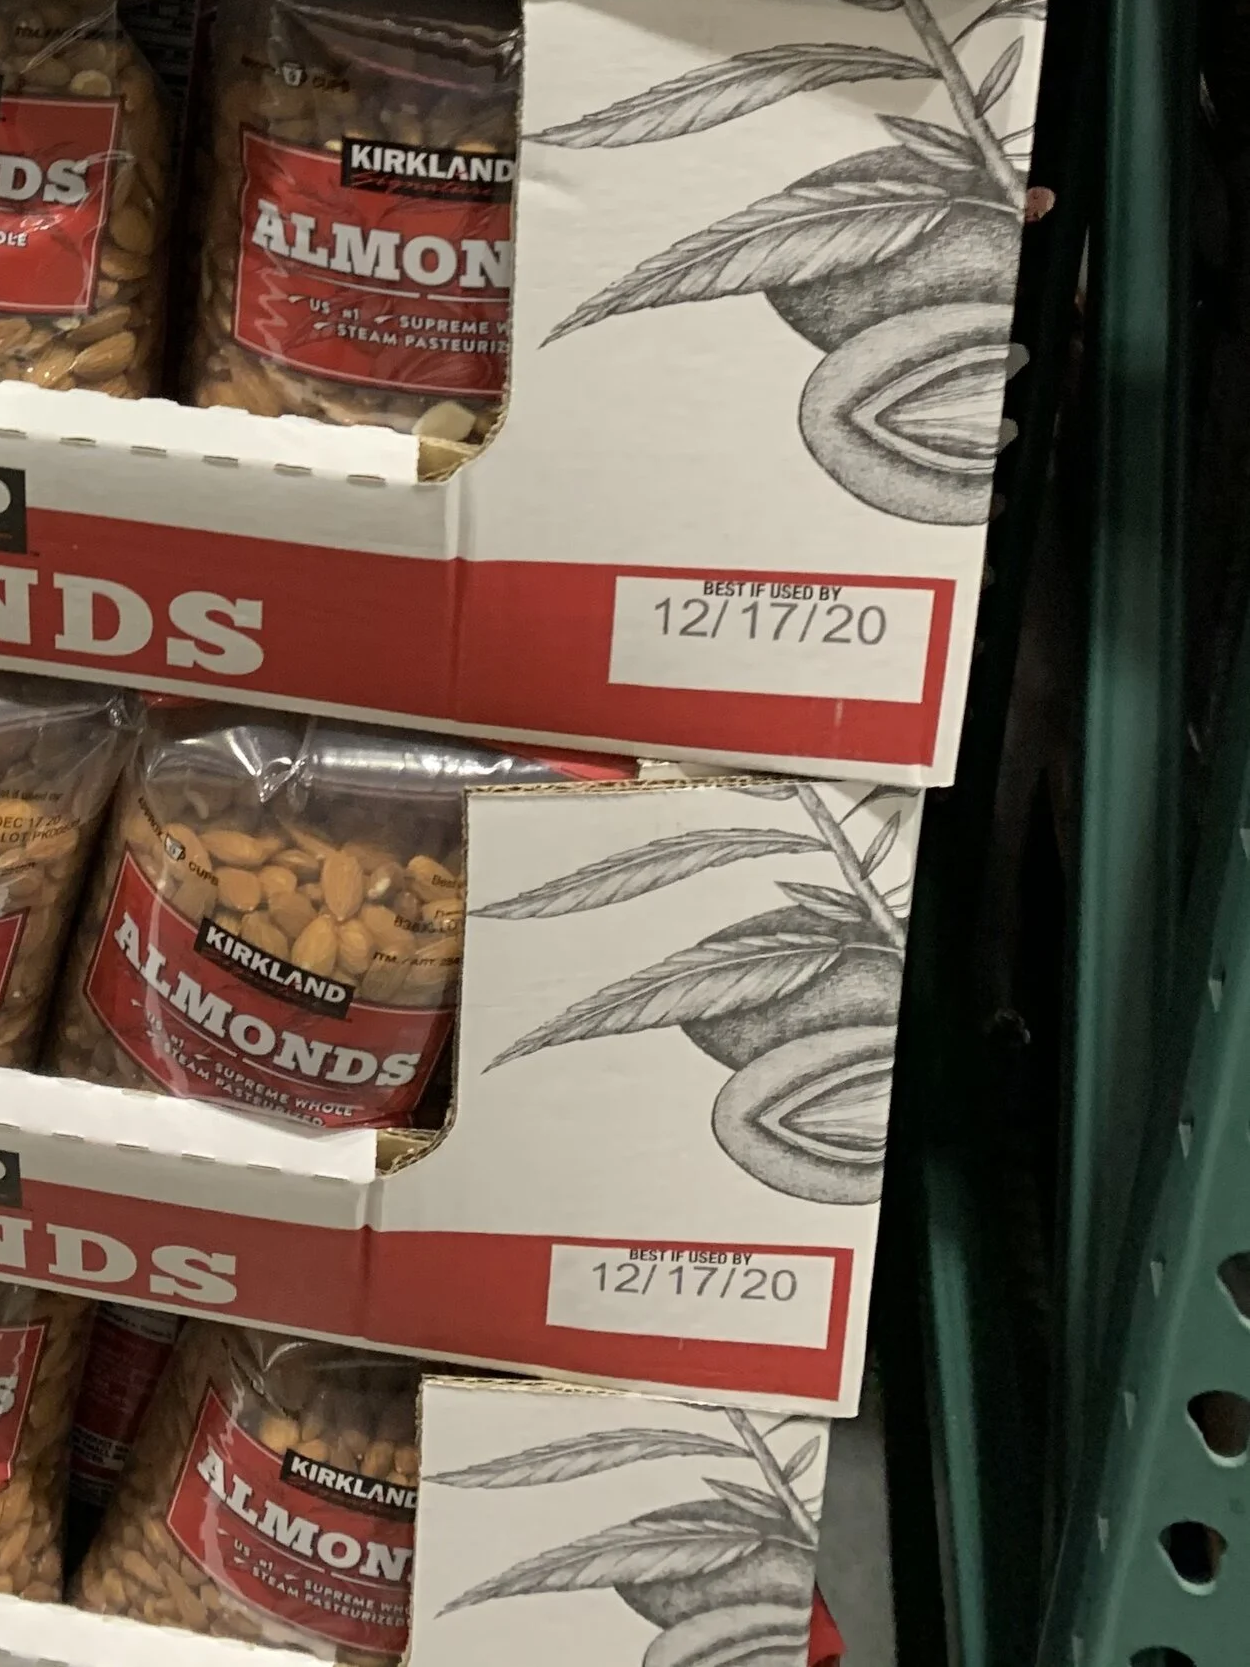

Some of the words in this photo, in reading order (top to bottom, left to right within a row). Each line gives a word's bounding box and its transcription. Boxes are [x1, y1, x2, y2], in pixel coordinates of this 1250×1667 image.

[351, 144, 516, 184] KIRKLAND
[309, 298, 331, 314] US
[399, 314, 490, 335] SUPREME
[337, 323, 398, 347] STEAM
[703, 580, 747, 598] BEST
[750, 582, 768, 598] IF
[770, 583, 814, 601] USED
[819, 585, 842, 602] BY
[654, 596, 887, 646] 12/17/20
[205, 925, 347, 1005] KIRKLAND
[113, 911, 421, 1089] ALMONDS
[164, 1041, 211, 1081] STEAM
[214, 1061, 291, 1104] SUPREME
[295, 1098, 354, 1117] WHOLE
[629, 1248, 667, 1262] BEST
[670, 1250, 685, 1263] IF
[688, 1251, 729, 1265] USED
[733, 1253, 753, 1266] BY
[592, 1261, 798, 1302] 12/17/20
[291, 1457, 418, 1510] KIRKLAND
[252, 1566, 299, 1598] STEAM
[304, 1578, 375, 1609] SUPREME
